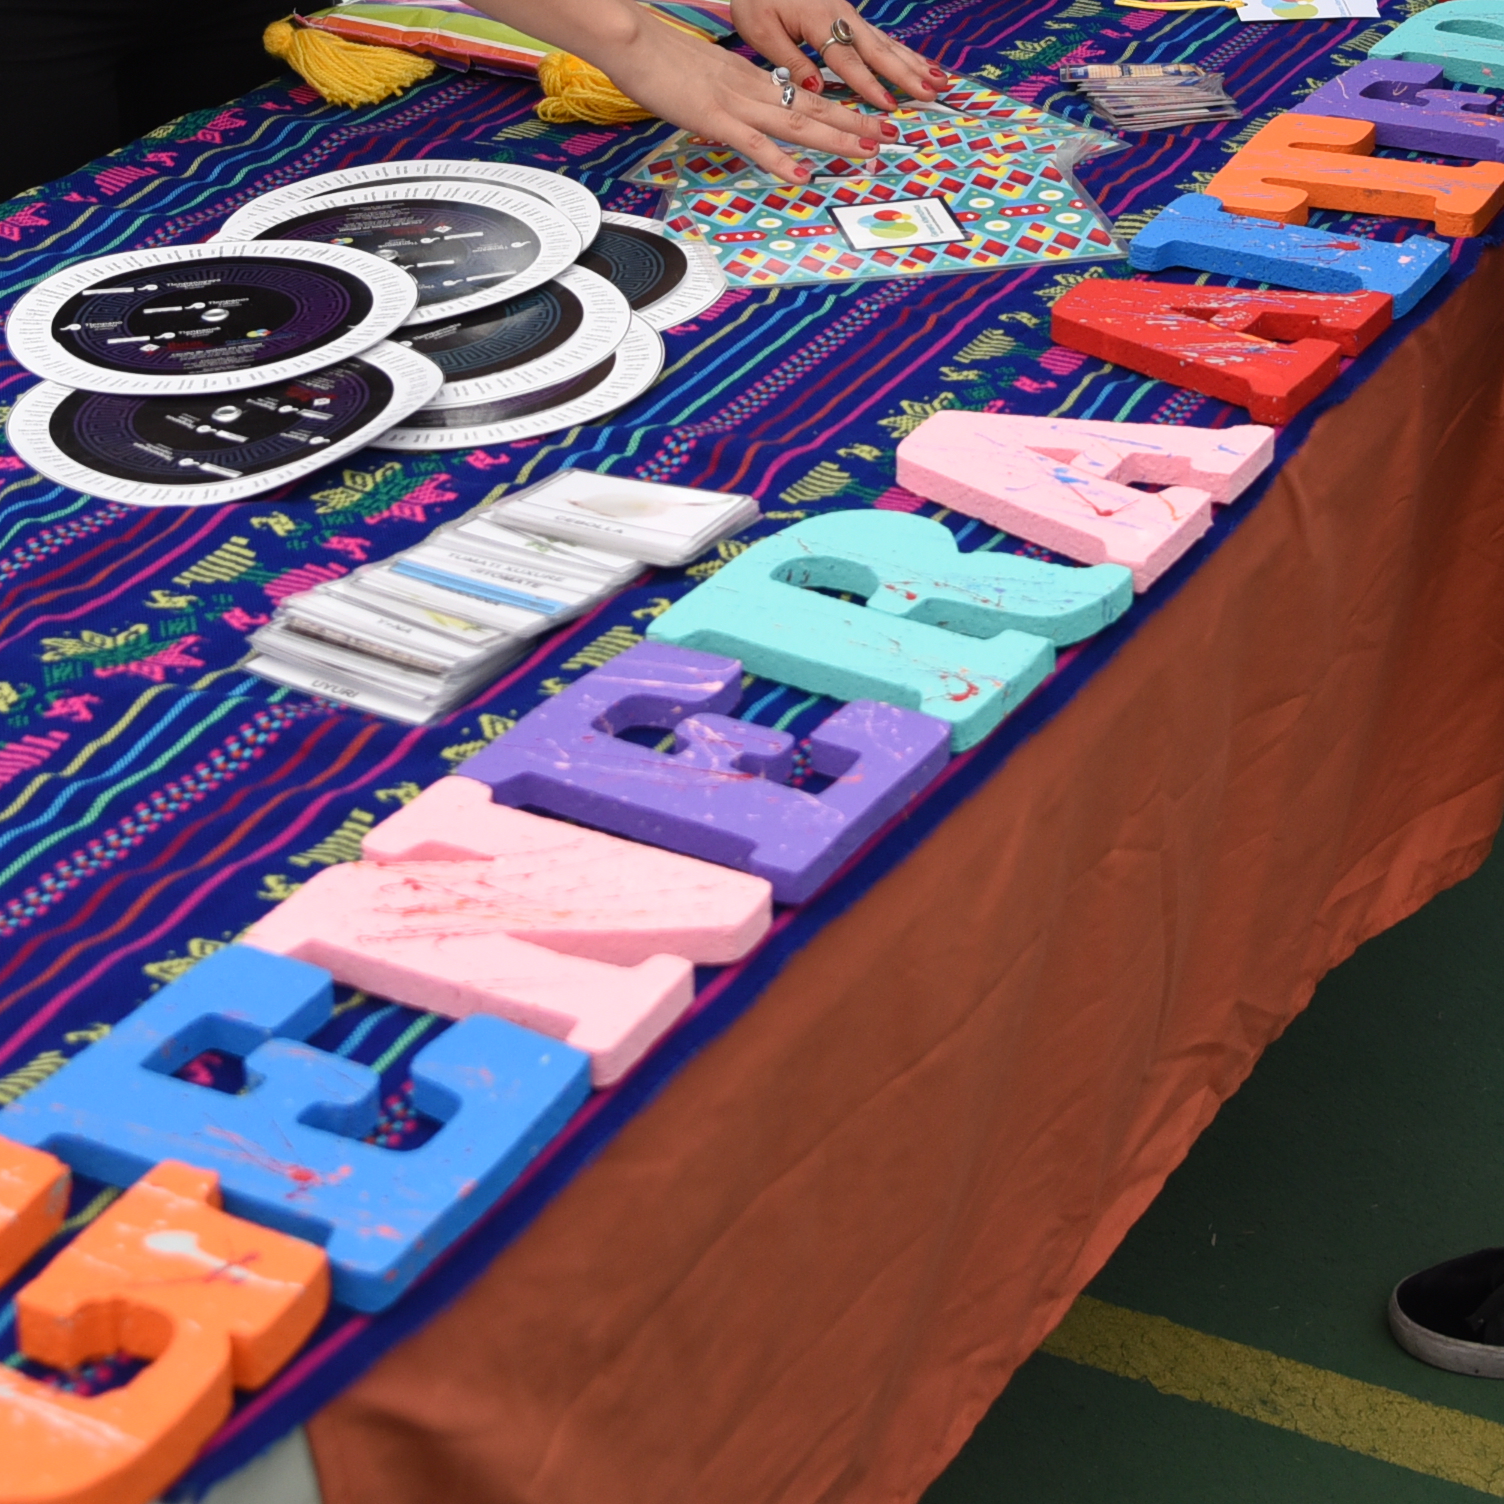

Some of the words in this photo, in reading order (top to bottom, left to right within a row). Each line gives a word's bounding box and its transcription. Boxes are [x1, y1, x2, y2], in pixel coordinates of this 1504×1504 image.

[554, 514, 624, 535] CEBOLLA
[470, 567, 544, 590] JITOMATE
[311, 679, 360, 699] UYURI
